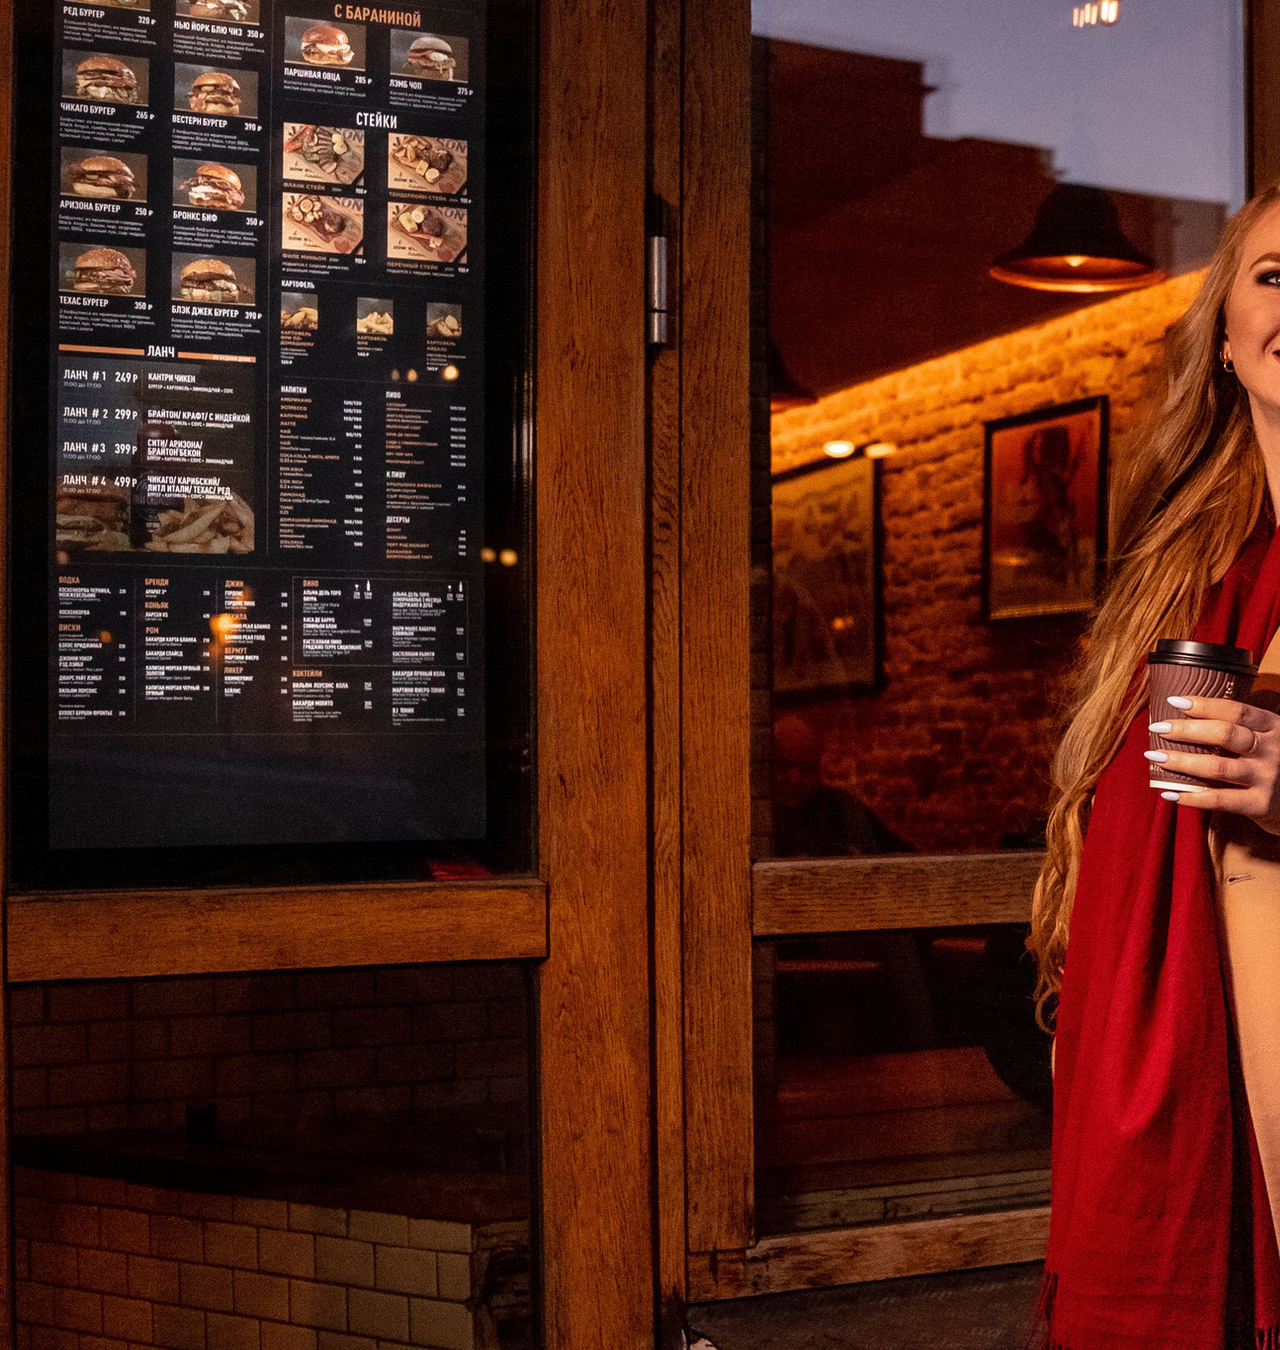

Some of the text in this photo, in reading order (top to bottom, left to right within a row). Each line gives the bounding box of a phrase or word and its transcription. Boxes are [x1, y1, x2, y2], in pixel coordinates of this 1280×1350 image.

[63, 6, 79, 16] РЕД
[79, 8, 105, 19] БУРГЕР
[138, 16, 150, 25] 320
[334, 3, 421, 28] С БАРАНИНОЙ
[174, 20, 190, 30] НЬЮ
[191, 21, 210, 33] ЙОРК
[211, 25, 227, 35] БЛЮ
[228, 27, 243, 37] ЧИЗ
[247, 30, 258, 39] 350
[284, 67, 321, 80] ПАРШИВАЯ
[322, 71, 341, 82] ОВЦА
[354, 75, 367, 84] 285
[389, 78, 408, 88] ЛЭМБ
[409, 81, 423, 90] ЧОП
[457, 87, 468, 96] 375
[60, 102, 89, 114] ЧИКАГО
[90, 105, 116, 116] БУРГЕР
[136, 110, 148, 120] 265
[172, 115, 202, 126] ВЕСТЕРН
[202, 118, 228, 128] БУРГЕР
[244, 123, 256, 132] 390
[356, 111, 397, 129] СТЕЙКИ
[59, 200, 93, 211] АРИЗОНА
[94, 203, 121, 213] БУРГЕР
[135, 207, 147, 216] 250
[173, 210, 200, 221] БРОНКС
[202, 213, 218, 222] БИФ
[246, 217, 258, 226] 350
[281, 279, 315, 289] КАРТОФЕЛЬ
[59, 296, 82, 306] ТЕХАС
[82, 298, 109, 308] БУРГЕР
[134, 301, 147, 310] 350
[171, 305, 190, 315] БЛЭК
[191, 306, 213, 317] ДЖЕК
[214, 308, 239, 318] БУРГЕР
[245, 311, 256, 320] 390
[147, 345, 175, 358] ЛАНЧ
[63, 369, 88, 380] ЛАНЧ
[114, 371, 132, 382] 249
[148, 373, 196, 383] КАНТРИ ЧИКЕН
[281, 385, 307, 394] НАПИТКИ
[63, 407, 88, 418] ЛАНЧ
[114, 409, 132, 420] 299
[148, 409, 181, 420] БРАЙТОН/
[182, 411, 207, 421] КРАФТ/
[215, 413, 250, 423] ИНДЕЙКОЙ
[63, 441, 88, 452] ЛАНЧ
[114, 443, 132, 454] 399
[147, 439, 203, 450] СИТИ/ АРИЗОНА/
[147, 448, 201, 458] БРАЙТОН БЕКОН
[63, 475, 88, 486] ЛАНЧ
[114, 477, 132, 488] 499
[386, 515, 410, 524] ДЕСЕРТЫ
[58, 576, 80, 584] ВОДКА
[144, 578, 169, 586] БРЕНДИ
